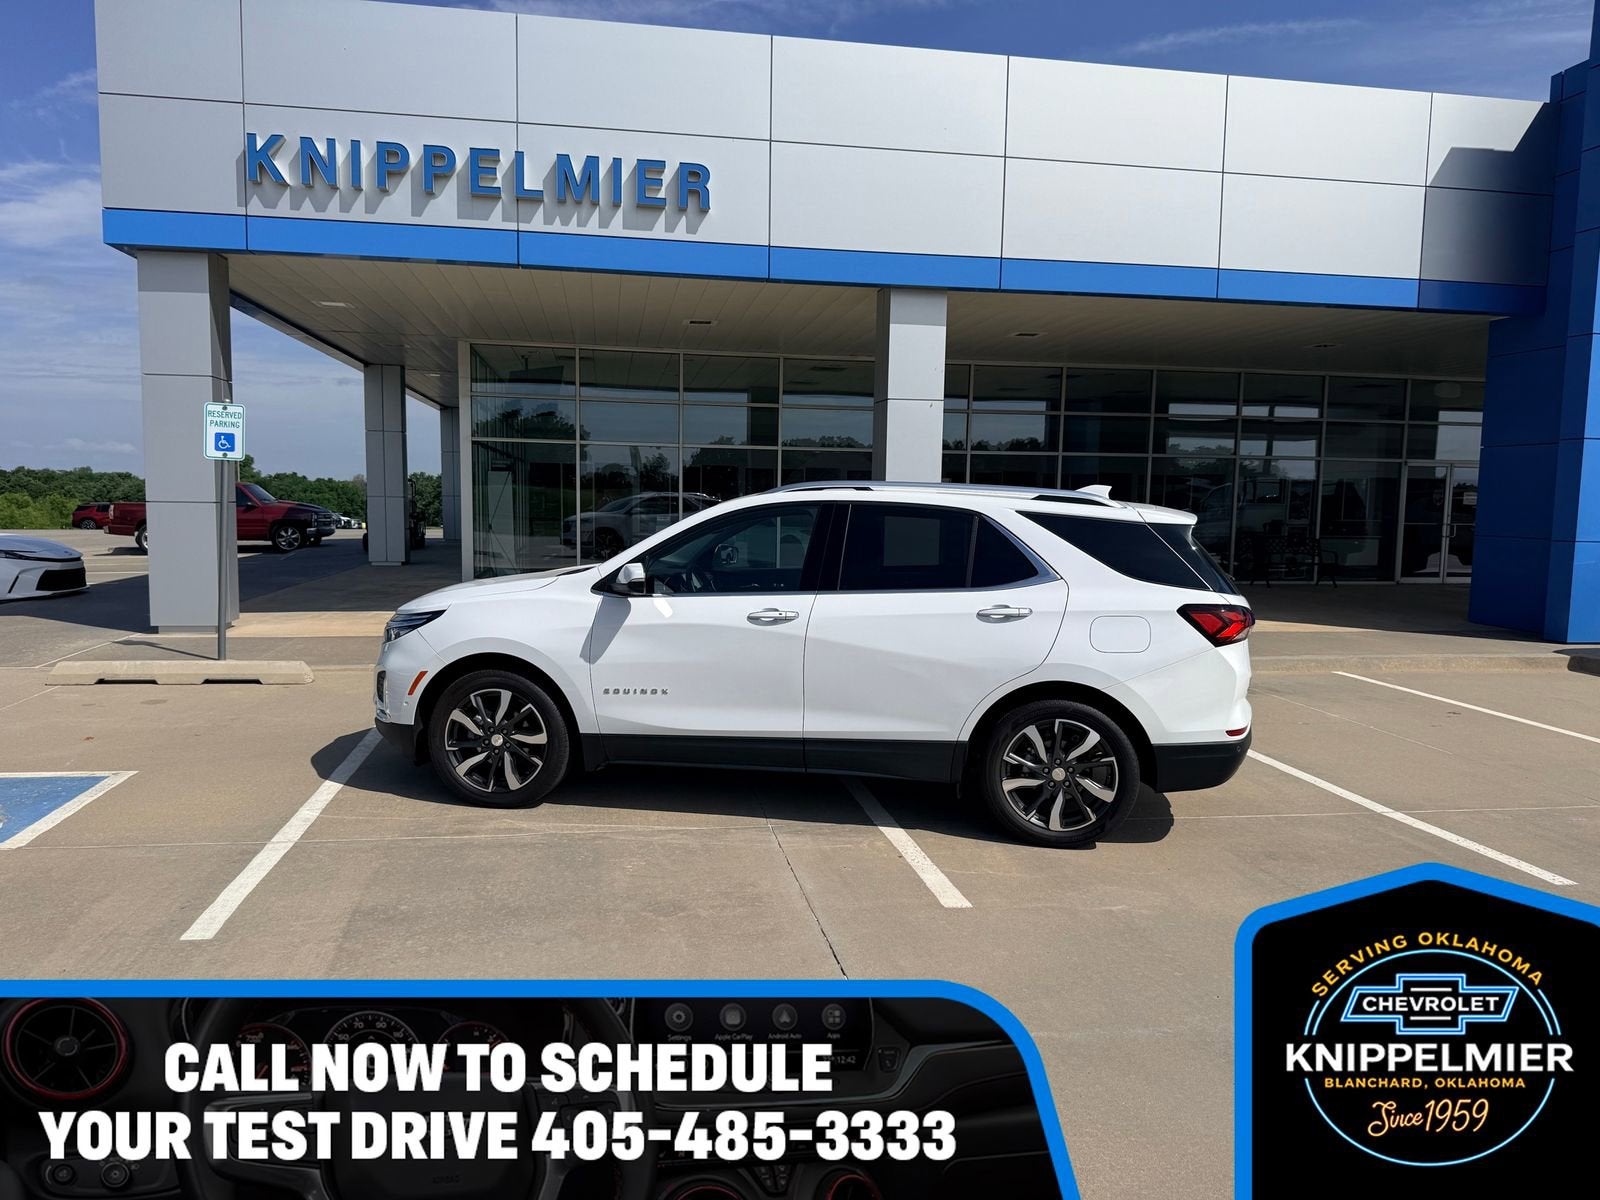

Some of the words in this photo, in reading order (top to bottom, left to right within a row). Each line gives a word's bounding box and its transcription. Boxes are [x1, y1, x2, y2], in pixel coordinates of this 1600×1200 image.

[246, 132, 711, 211] KNIPPELMIER
[207, 410, 242, 419] RESERVED
[209, 420, 240, 429] PARKING
